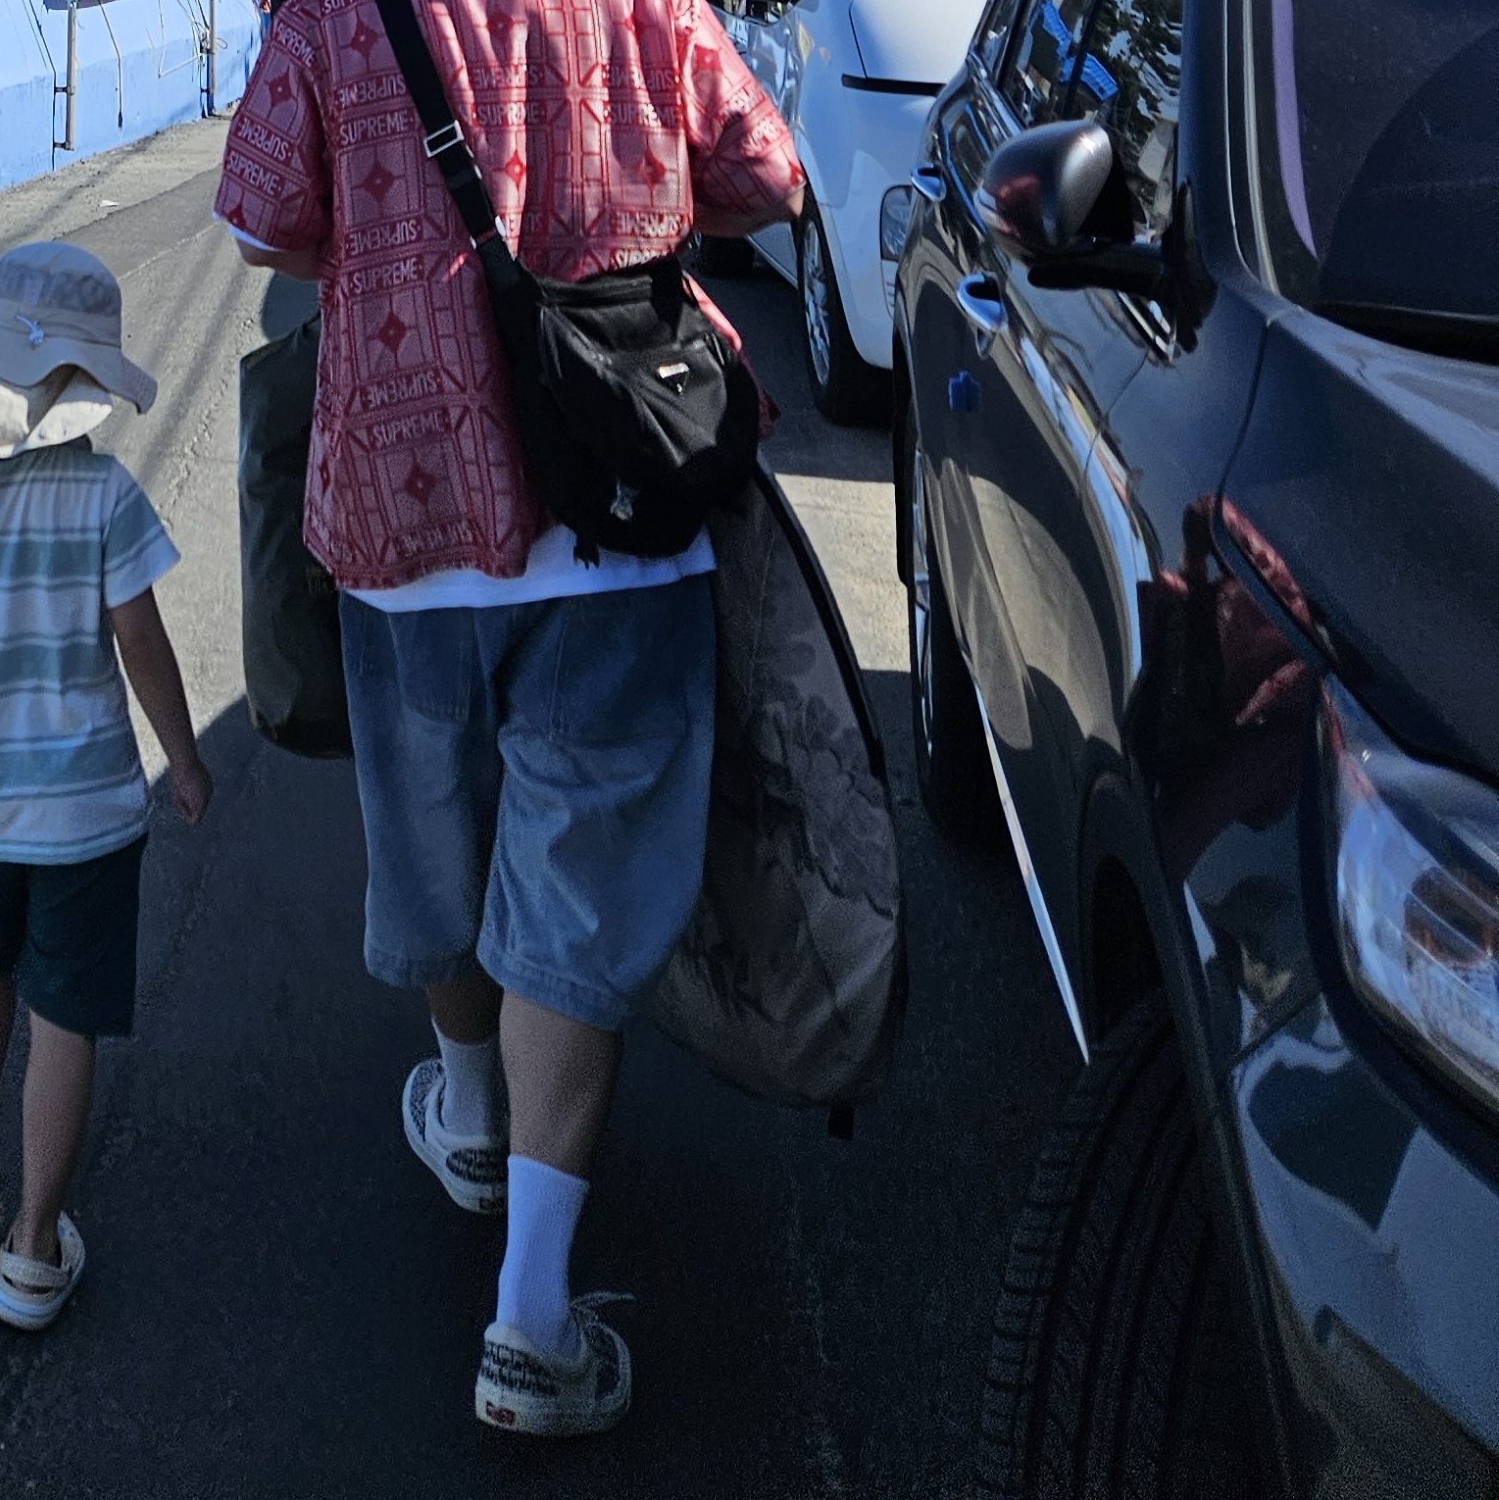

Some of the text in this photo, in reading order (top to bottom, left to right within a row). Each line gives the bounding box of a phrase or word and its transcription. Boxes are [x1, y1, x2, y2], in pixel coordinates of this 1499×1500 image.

[239, 117, 289, 161] SUPREME
[339, 112, 408, 145] SUPREME
[226, 151, 279, 193] SUPREME
[350, 219, 417, 255] SUPREME
[352, 257, 419, 293] SUPREME
[373, 410, 445, 447] SUPREME
